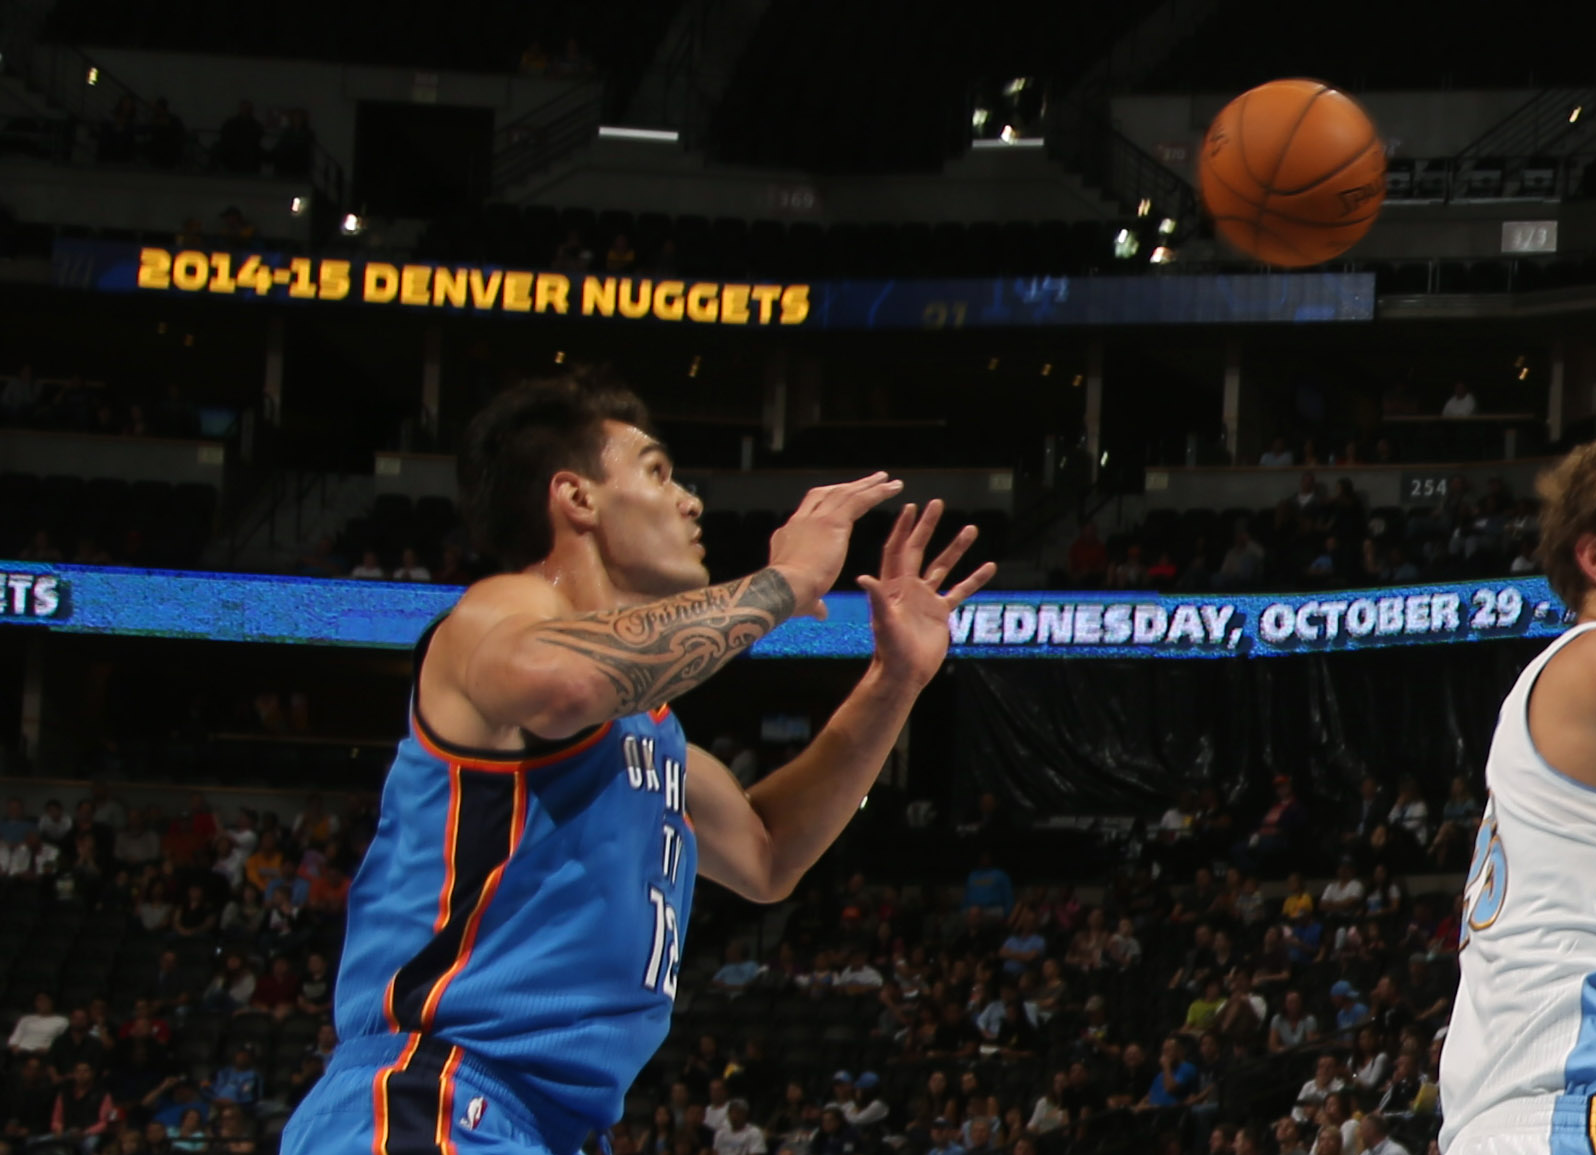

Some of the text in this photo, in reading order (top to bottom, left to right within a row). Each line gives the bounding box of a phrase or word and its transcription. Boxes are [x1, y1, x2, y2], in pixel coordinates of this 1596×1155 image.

[138, 247, 810, 325] 2014-15 DENVER NUGGETS
[1410, 478, 1448, 497] 254
[0, 573, 59, 616] TS
[1260, 592, 1461, 644] OCTOBER
[1471, 586, 1524, 630] 29
